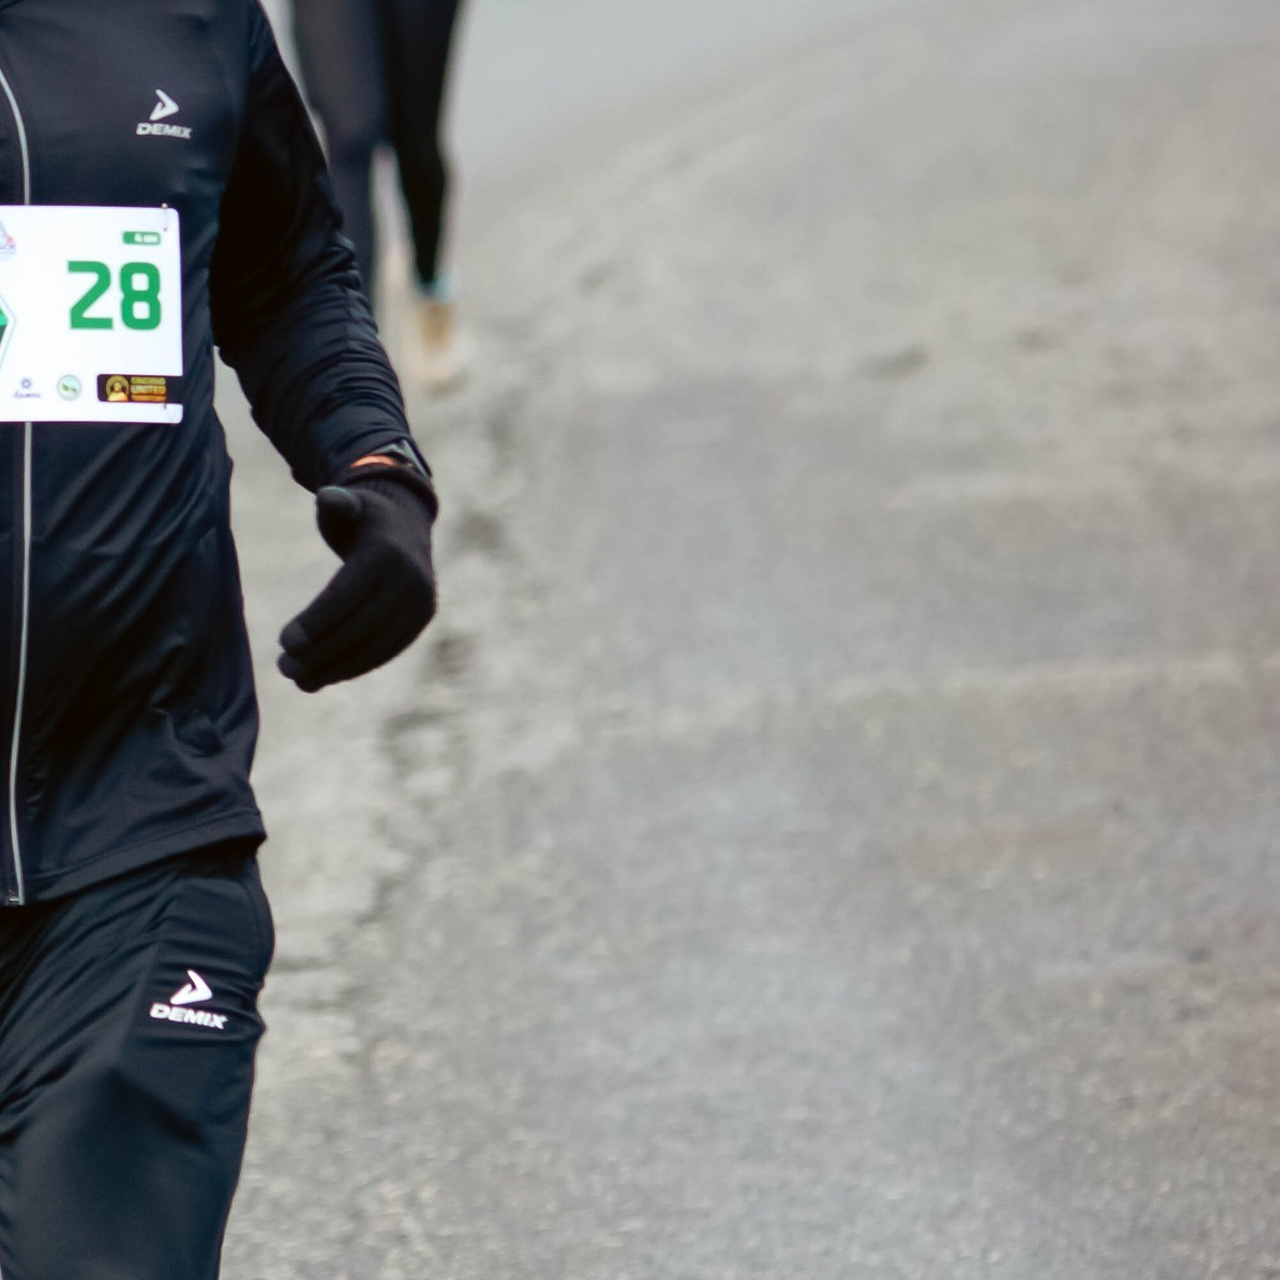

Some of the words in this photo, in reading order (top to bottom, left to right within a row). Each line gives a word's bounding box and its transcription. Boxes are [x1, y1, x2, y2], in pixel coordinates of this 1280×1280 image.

[136, 122, 192, 139] DEMIX
[67, 260, 162, 330] 28
[149, 1002, 228, 1030] DEMIX
